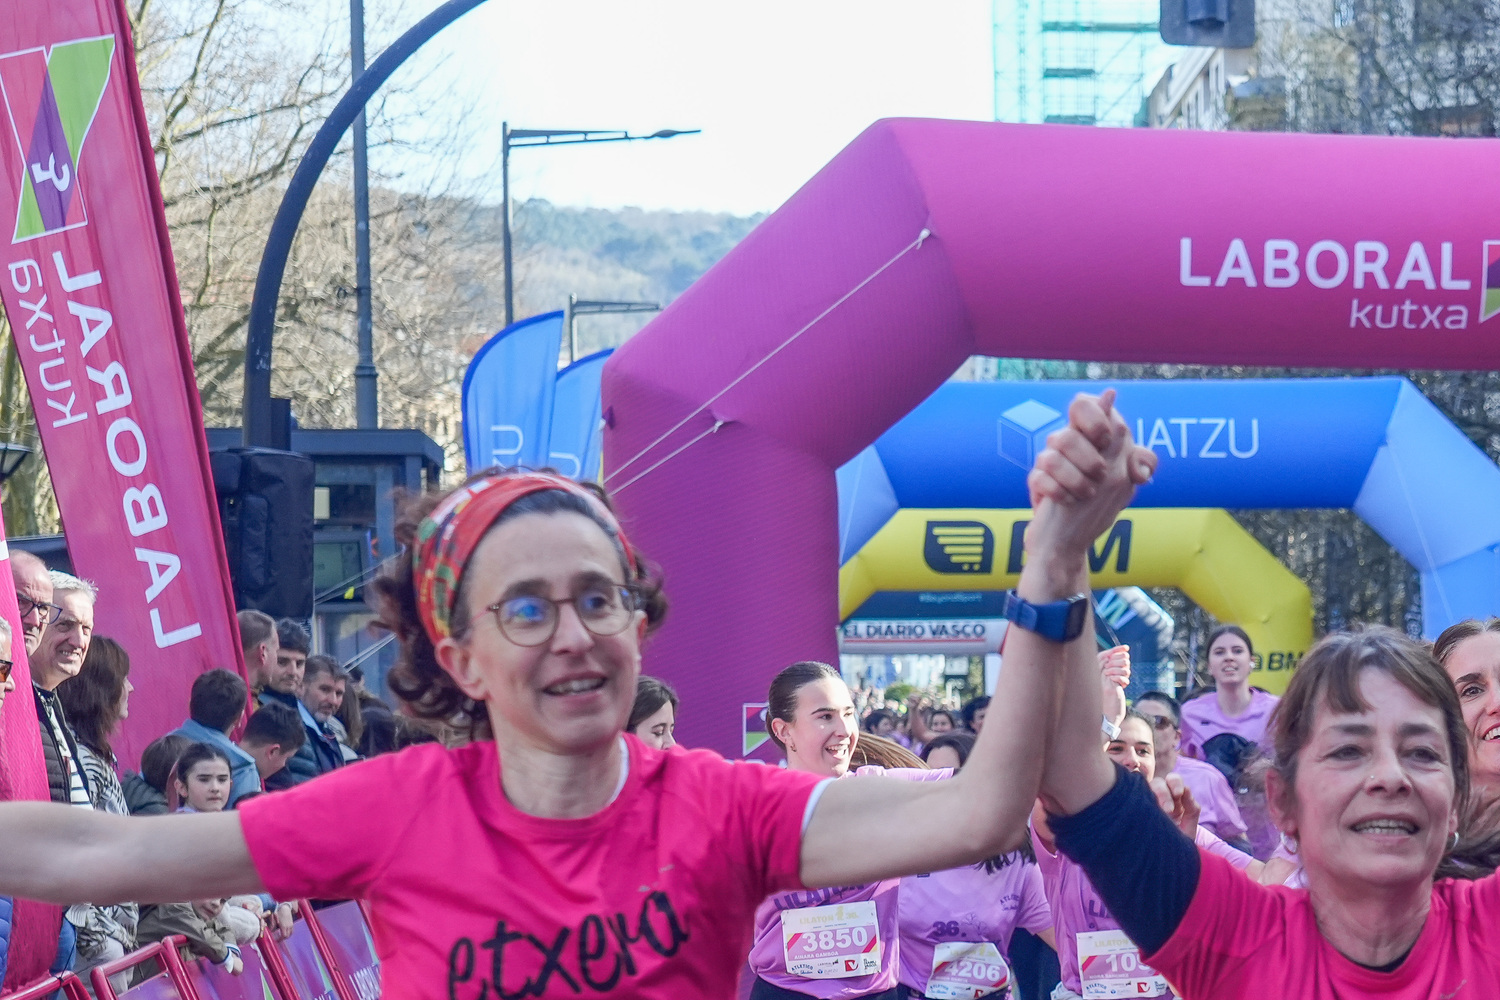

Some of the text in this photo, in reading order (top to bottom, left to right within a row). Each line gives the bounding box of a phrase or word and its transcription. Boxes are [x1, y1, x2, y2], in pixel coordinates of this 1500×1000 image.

[1179, 236, 1472, 291] LABORAL
[1349, 297, 1470, 330] kutxa
[1133, 418, 1260, 459] ATZU
[866, 624, 925, 637] DIARIO
[929, 623, 986, 637] VASCO
[801, 926, 868, 953] 3850
[944, 960, 1001, 982] 4206
